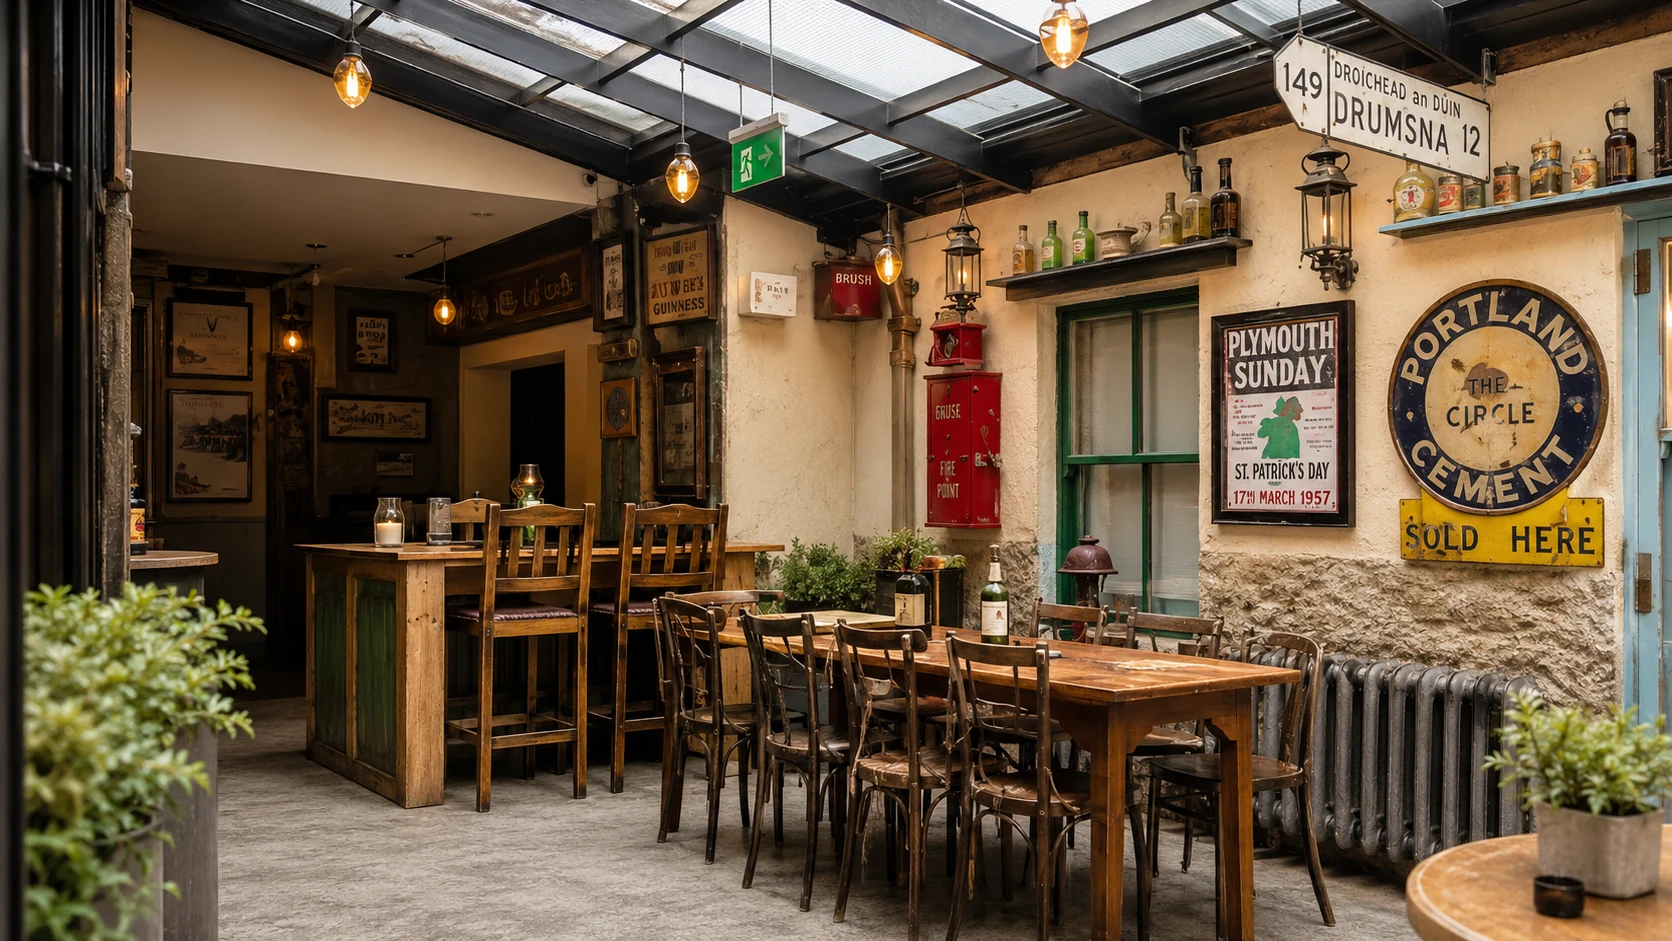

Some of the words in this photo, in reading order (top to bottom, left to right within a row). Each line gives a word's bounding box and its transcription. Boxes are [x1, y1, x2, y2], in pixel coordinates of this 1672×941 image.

[1283, 62, 1322, 99] 149
[1413, 90, 1428, 108] an
[1334, 91, 1449, 155] DRUMSNA
[1462, 123, 1481, 157] 12
[835, 273, 872, 286] BRUSH
[653, 297, 705, 316] GUINNESS
[1228, 320, 1334, 358] PLYMOUTH
[1401, 291, 1589, 385] PORTLAND
[1234, 354, 1327, 389] SUNDAY
[1467, 376, 1505, 395] THE
[1446, 402, 1535, 428] CIRCLE
[1235, 463, 1249, 480] ST.
[1252, 460, 1304, 480] PATRICK'S
[1308, 462, 1330, 480] DAY
[1411, 434, 1574, 504] CEMENT
[936, 483, 959, 499] POINT
[1259, 491, 1295, 505] MARCH
[1300, 490, 1331, 505] 1957
[1405, 524, 1478, 551] SOLD
[1511, 525, 1595, 554] HERE
